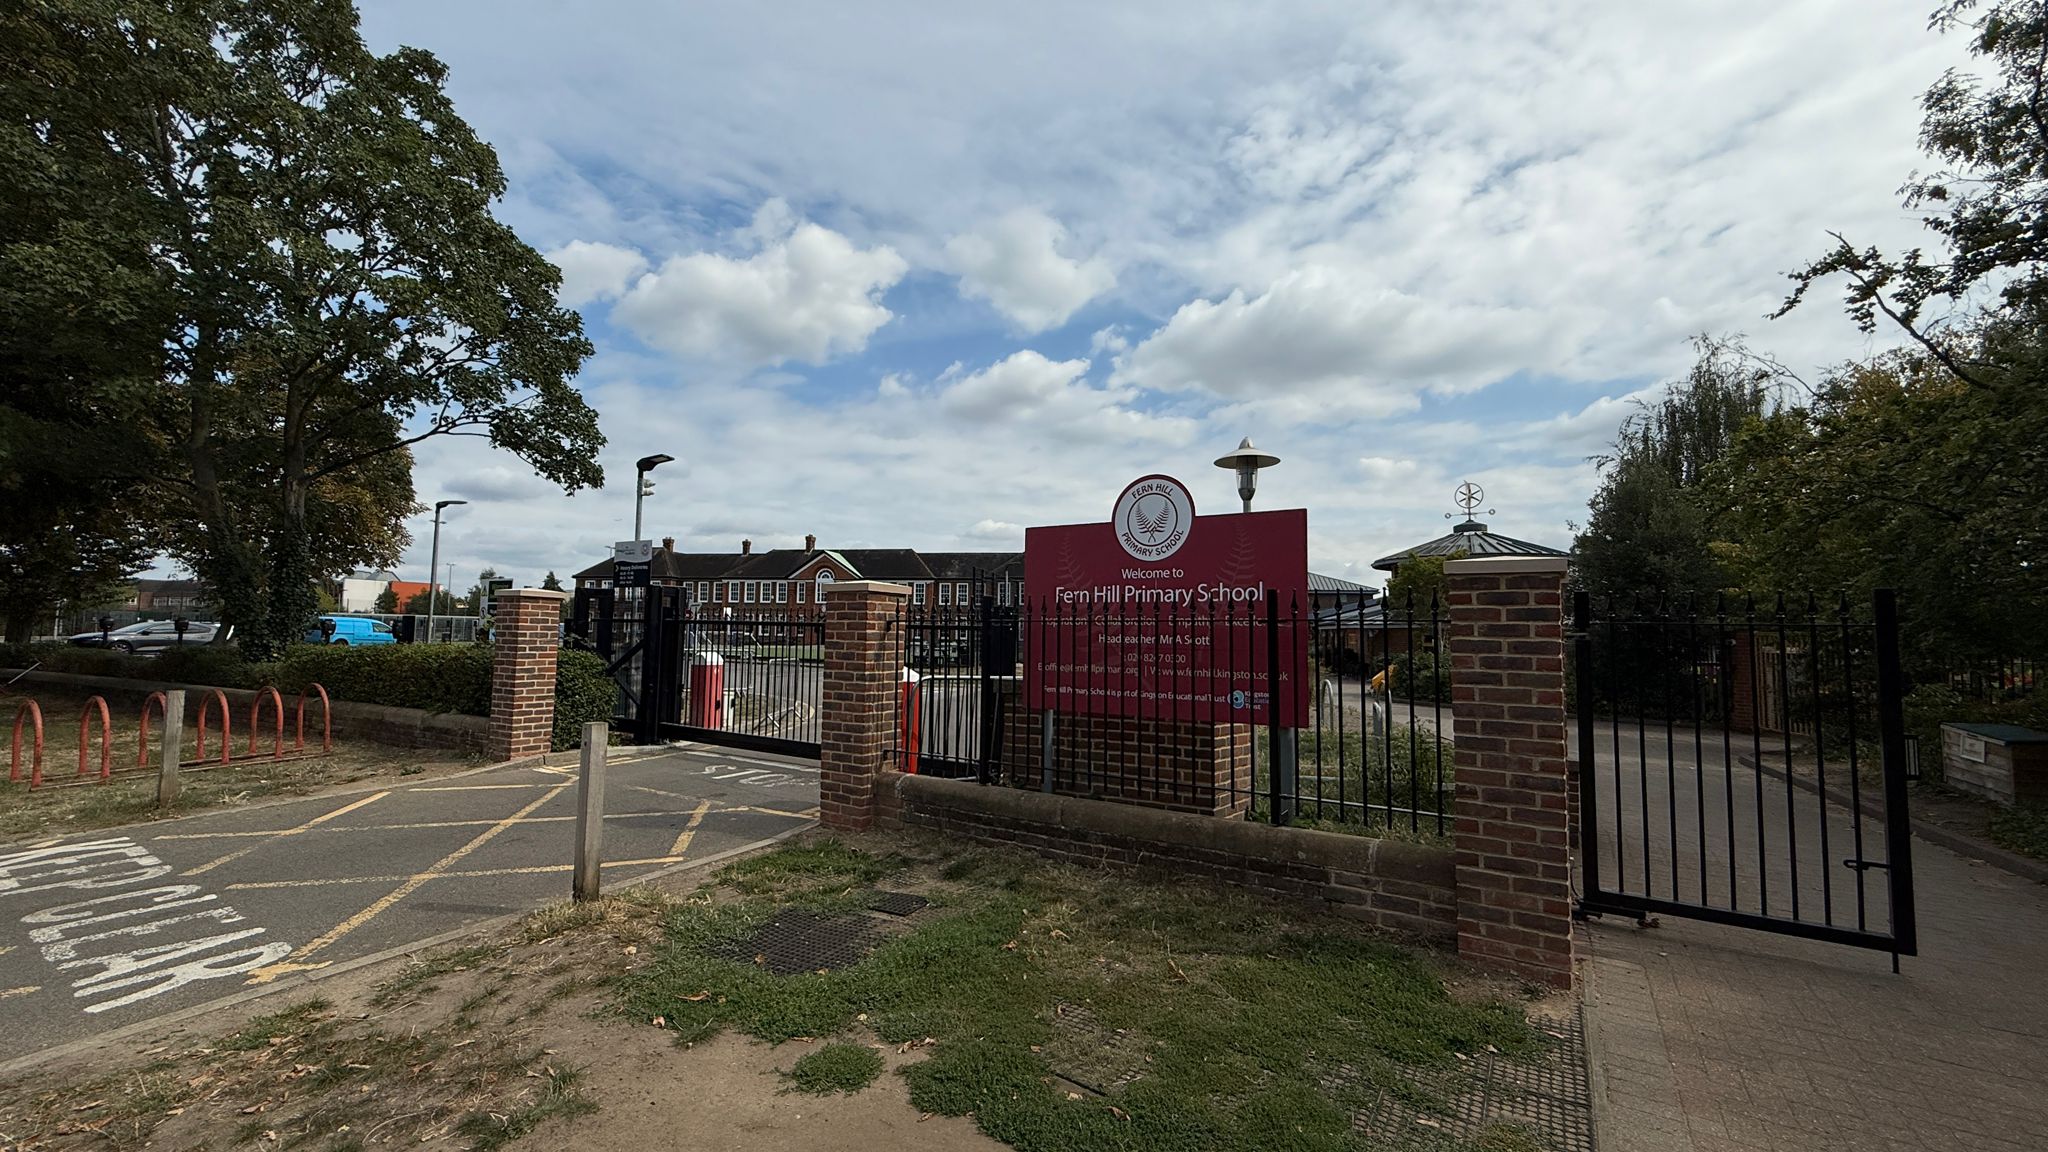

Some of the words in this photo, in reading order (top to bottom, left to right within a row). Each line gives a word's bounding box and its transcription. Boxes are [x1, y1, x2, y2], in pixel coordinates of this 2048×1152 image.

[1131, 483, 1153, 499] FERN
[1155, 483, 1174, 497] HILL
[1121, 531, 1154, 557] PRIMARY
[1155, 529, 1184, 556] SCHOOL
[1121, 568, 1170, 579] Welcome
[1172, 567, 1184, 579] to
[1055, 586, 1090, 603] Fern
[1094, 584, 1120, 603] Hill
[1125, 584, 1193, 608] Primary
[1197, 580, 1264, 602] School
[1040, 615, 1088, 628] Inspraton
[1098, 633, 1156, 645] Headeacher
[1159, 634, 1174, 645] Mr
[1175, 634, 1184, 645] A
[1127, 652, 1142, 662] 02
[1067, 687, 1088, 697] Prmary
[1090, 688, 1111, 697] Schol
[1117, 690, 1130, 699] prt
[1140, 691, 1167, 701] ingson
[1168, 692, 1208, 702] Eucatinal
[1208, 694, 1226, 703] Tust
[19, 884, 294, 1014] CLEAR
